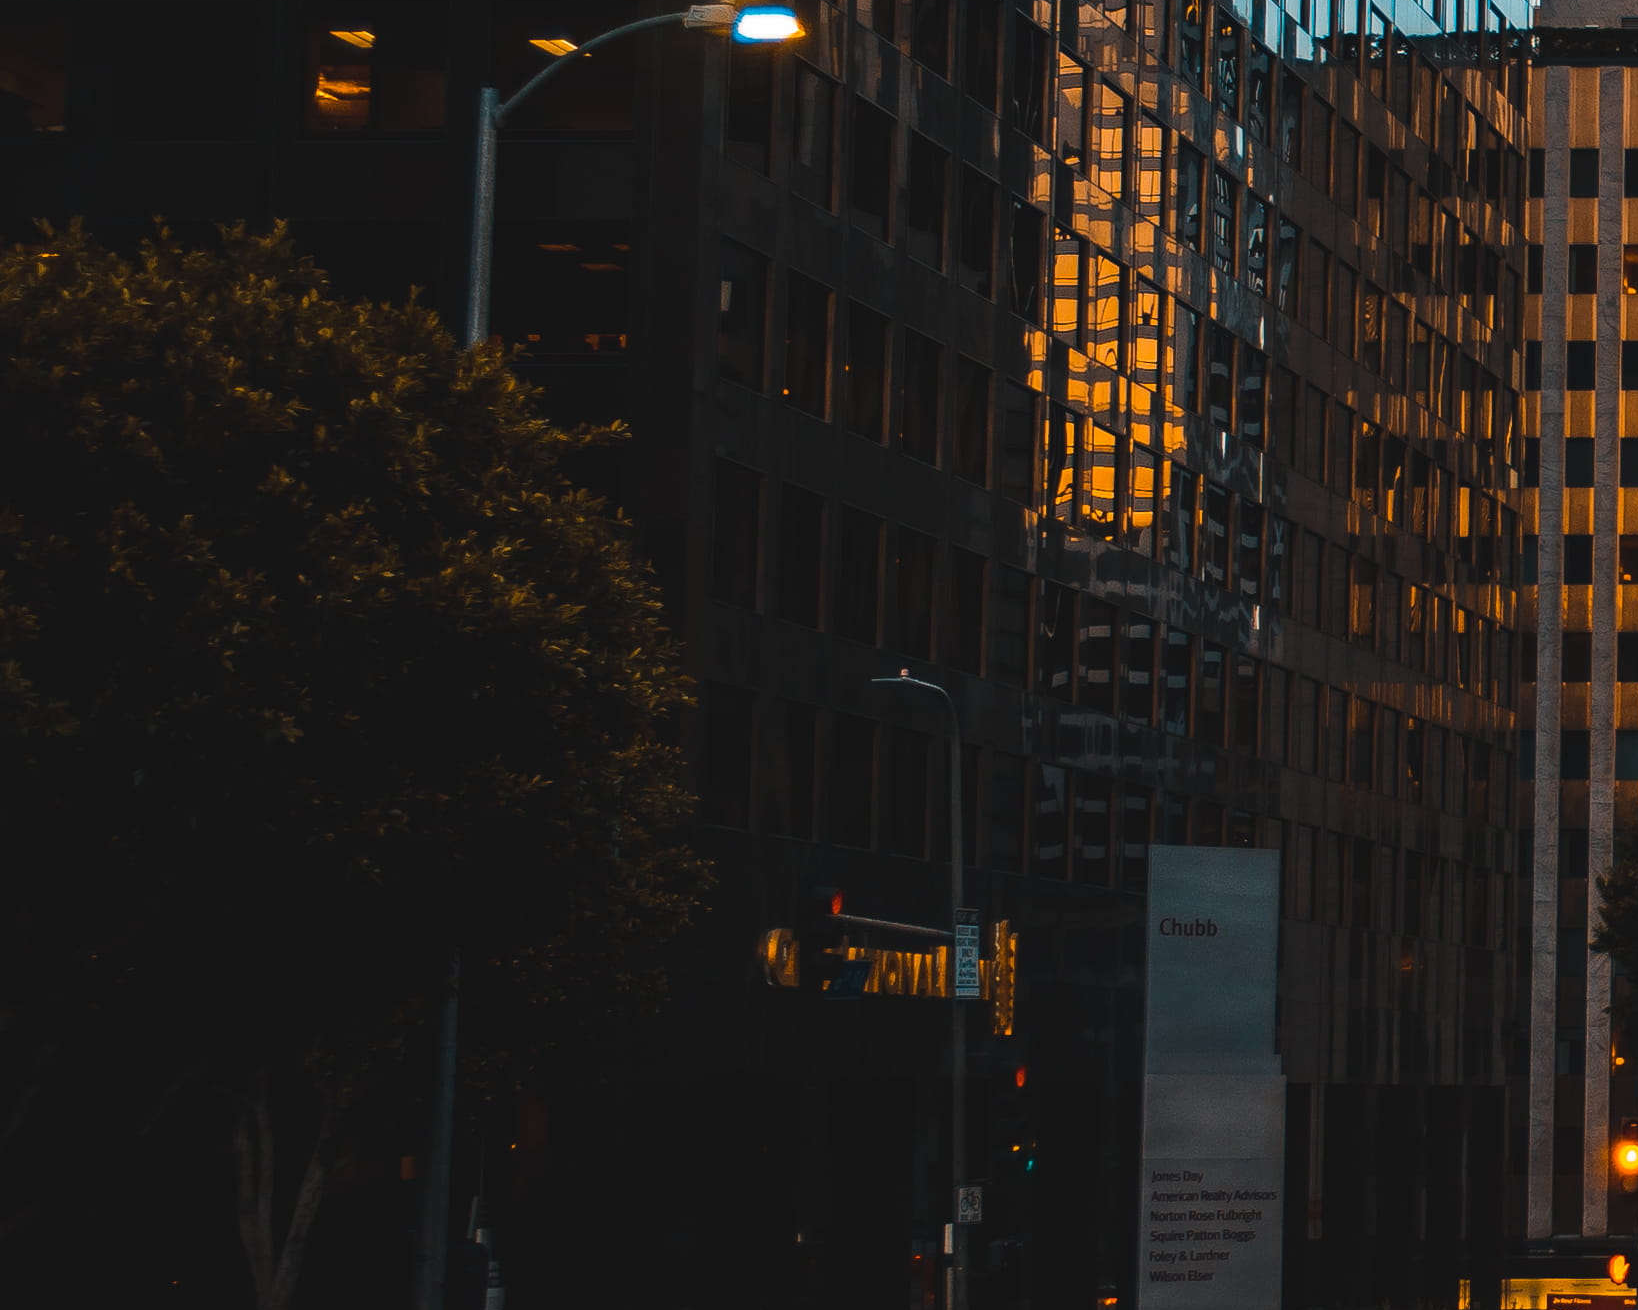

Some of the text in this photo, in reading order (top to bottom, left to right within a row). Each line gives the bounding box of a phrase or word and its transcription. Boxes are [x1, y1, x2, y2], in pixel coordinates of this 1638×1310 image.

[1160, 918, 1218, 937] Chubb
[1152, 1170, 1204, 1184] Jones Day
[1151, 1190, 1277, 1203] American Realty Advisors
[1150, 1209, 1262, 1223] Norton Rose Fulbright
[1150, 1229, 1256, 1244] Squire Patton Boggs
[1149, 1249, 1230, 1264] Foley & Lardner
[1150, 1270, 1214, 1282] Wilson Elser
